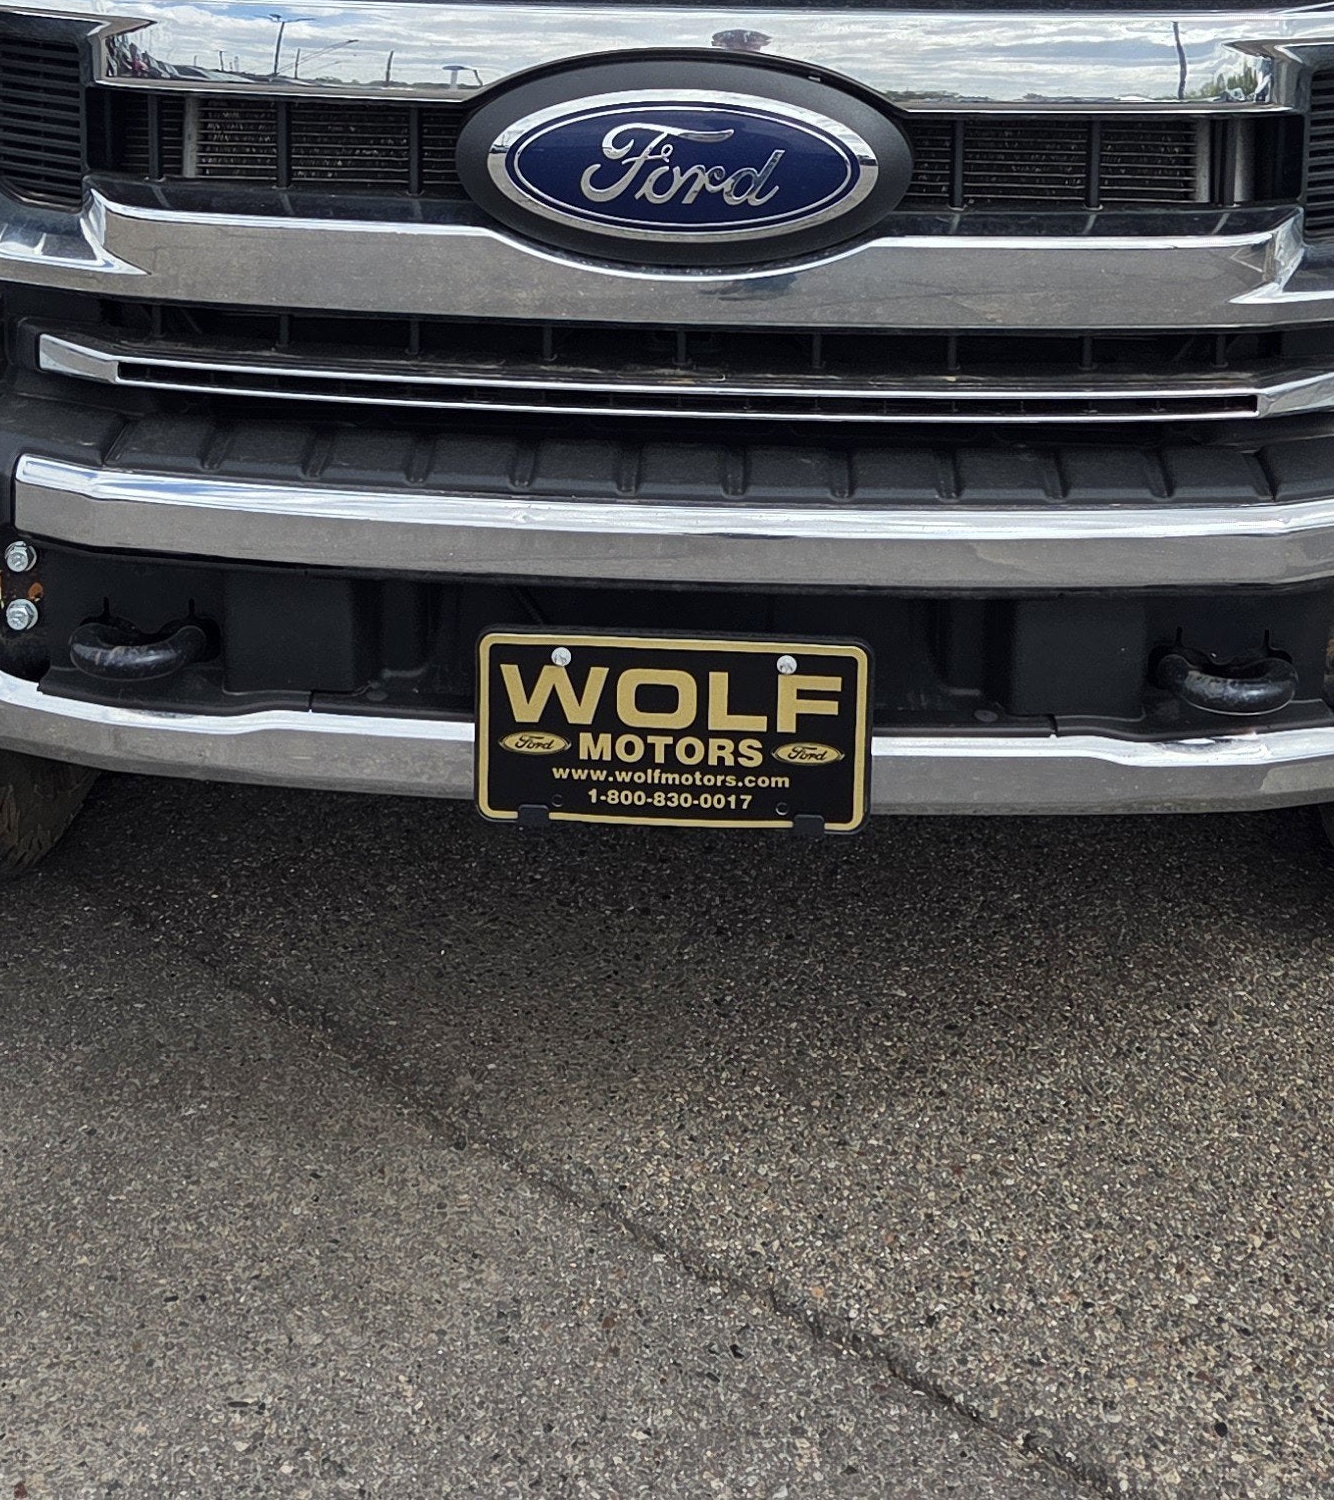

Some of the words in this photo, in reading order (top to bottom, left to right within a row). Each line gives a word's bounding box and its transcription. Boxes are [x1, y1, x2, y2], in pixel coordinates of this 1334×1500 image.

[580, 122, 786, 206] Ford
[500, 663, 842, 734] WOLF
[514, 735, 555, 752] Ford
[579, 733, 763, 768] MOTORS
[786, 746, 829, 763] Ford
[552, 767, 790, 789] www.wolfmotors.com
[588, 789, 753, 811] 1-800-830-0017
